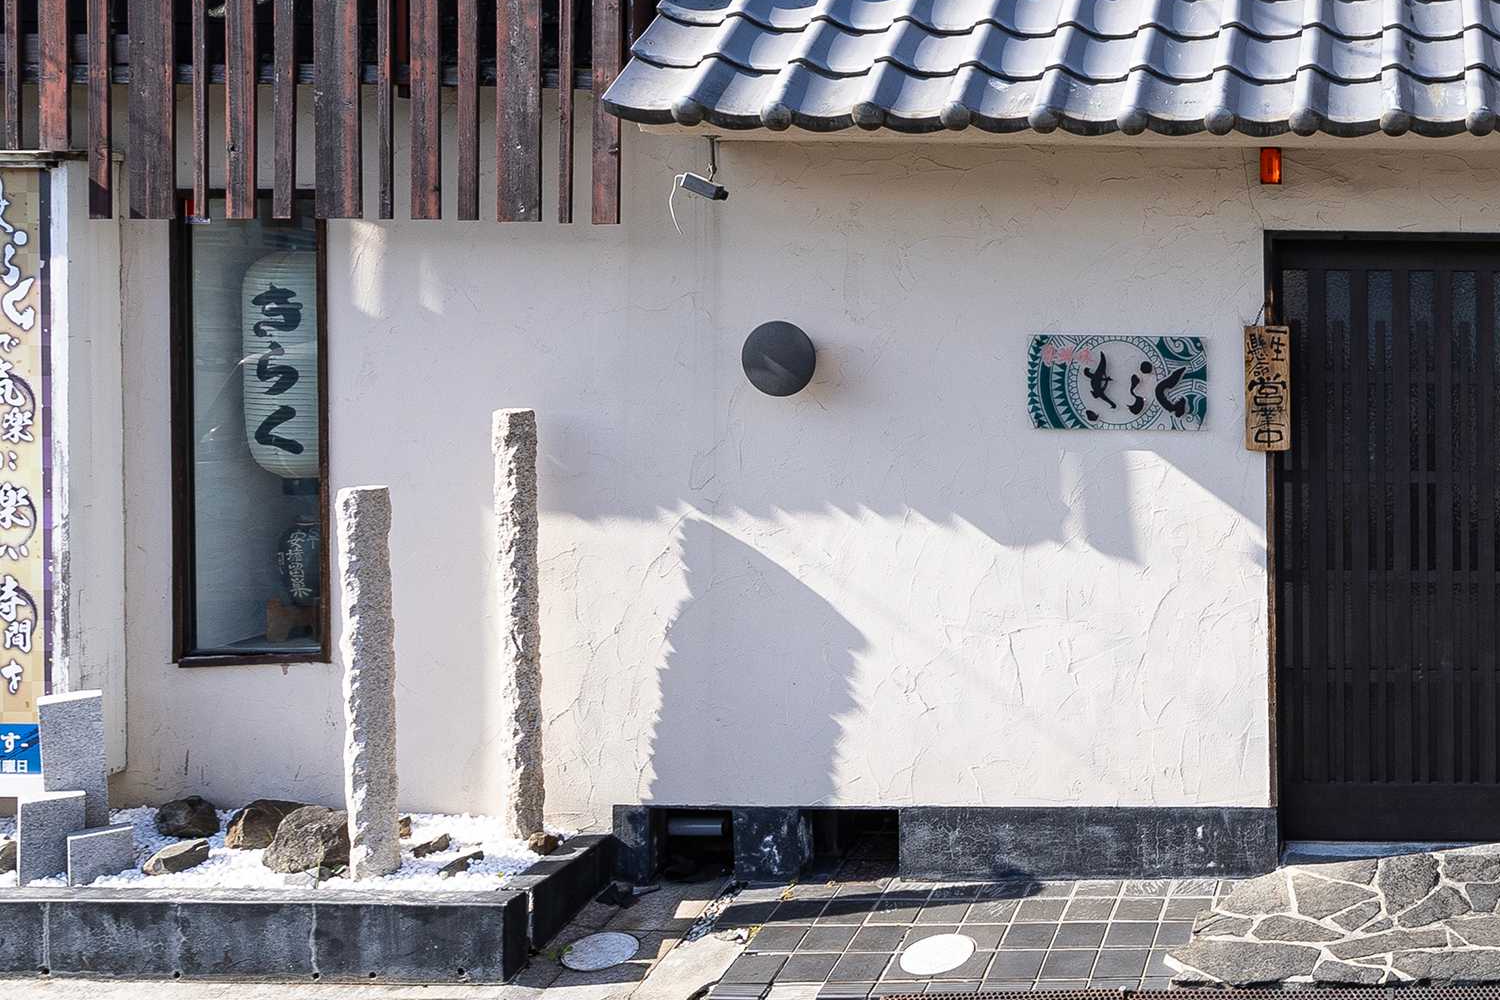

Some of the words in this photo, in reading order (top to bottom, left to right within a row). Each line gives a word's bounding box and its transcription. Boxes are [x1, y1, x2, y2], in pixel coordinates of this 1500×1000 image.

[251, 281, 305, 456] きらく
[1265, 327, 1288, 362] 一生
[1083, 350, 1188, 423] きらく
[1247, 372, 1288, 448] 営業中
[0, 759, 29, 773] 曜日
